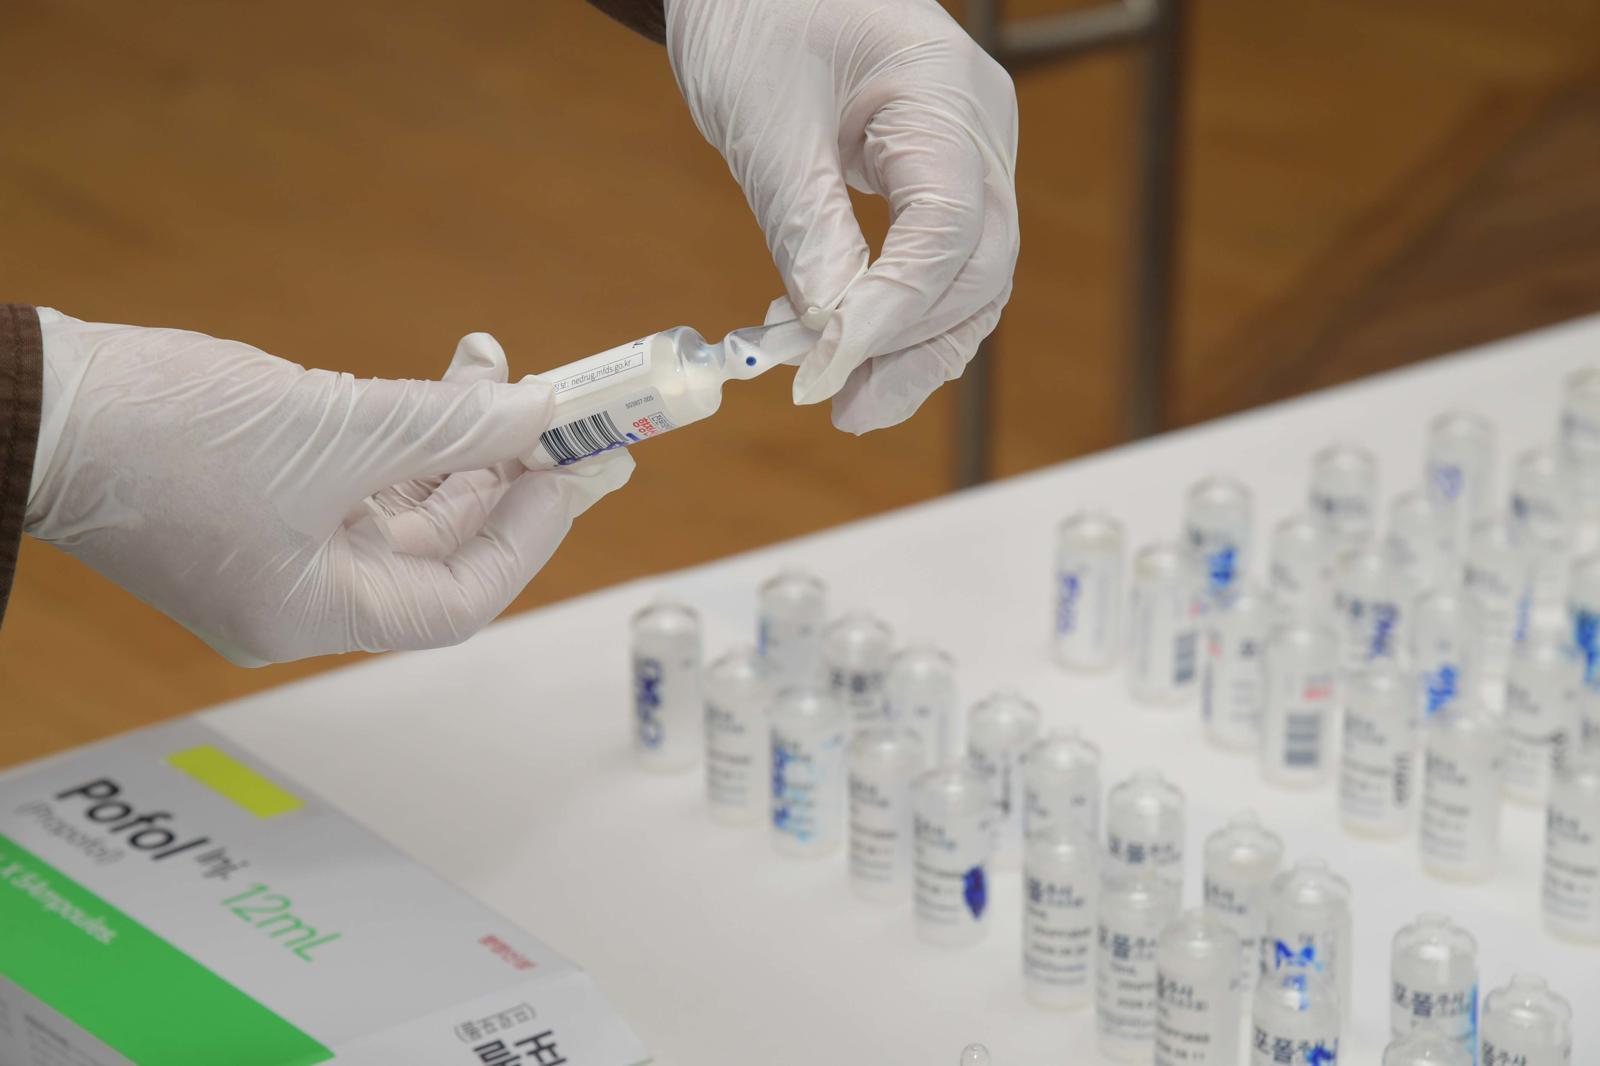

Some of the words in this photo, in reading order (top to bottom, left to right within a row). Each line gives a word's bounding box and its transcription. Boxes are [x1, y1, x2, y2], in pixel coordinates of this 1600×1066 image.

[571, 360, 632, 385] nedrug.mfds.go.kr
[53, 776, 211, 861] Pofol
[220, 883, 343, 963] 12mL
